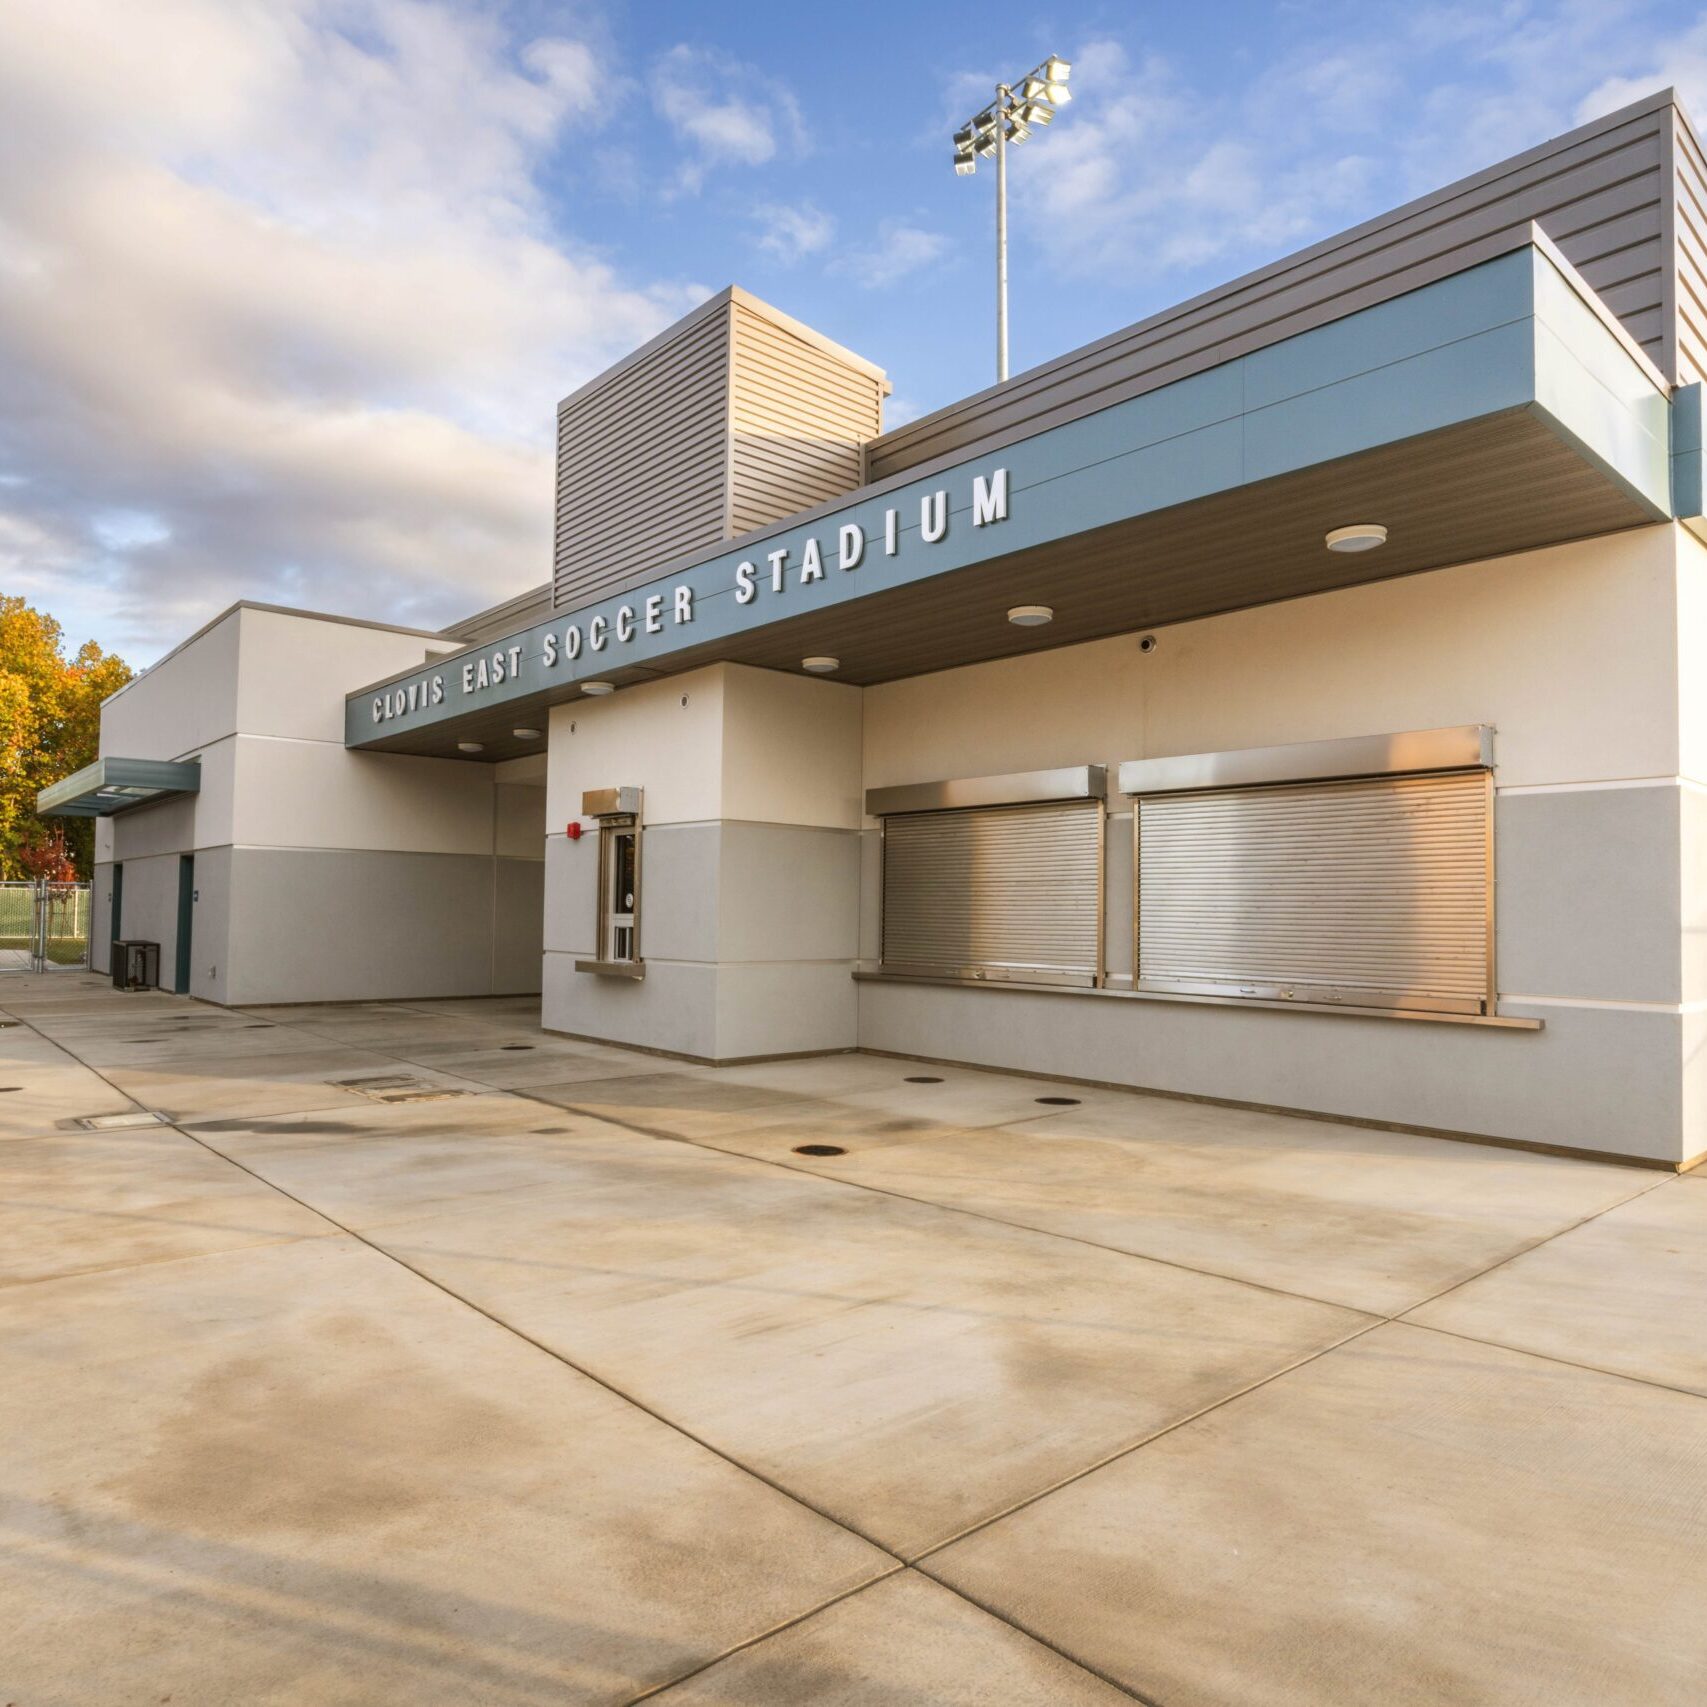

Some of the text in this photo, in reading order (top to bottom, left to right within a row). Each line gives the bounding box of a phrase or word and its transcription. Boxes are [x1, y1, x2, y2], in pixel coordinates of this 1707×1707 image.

[372, 468, 1008, 723] CLOVIS EAST SOCCER STADIUM
